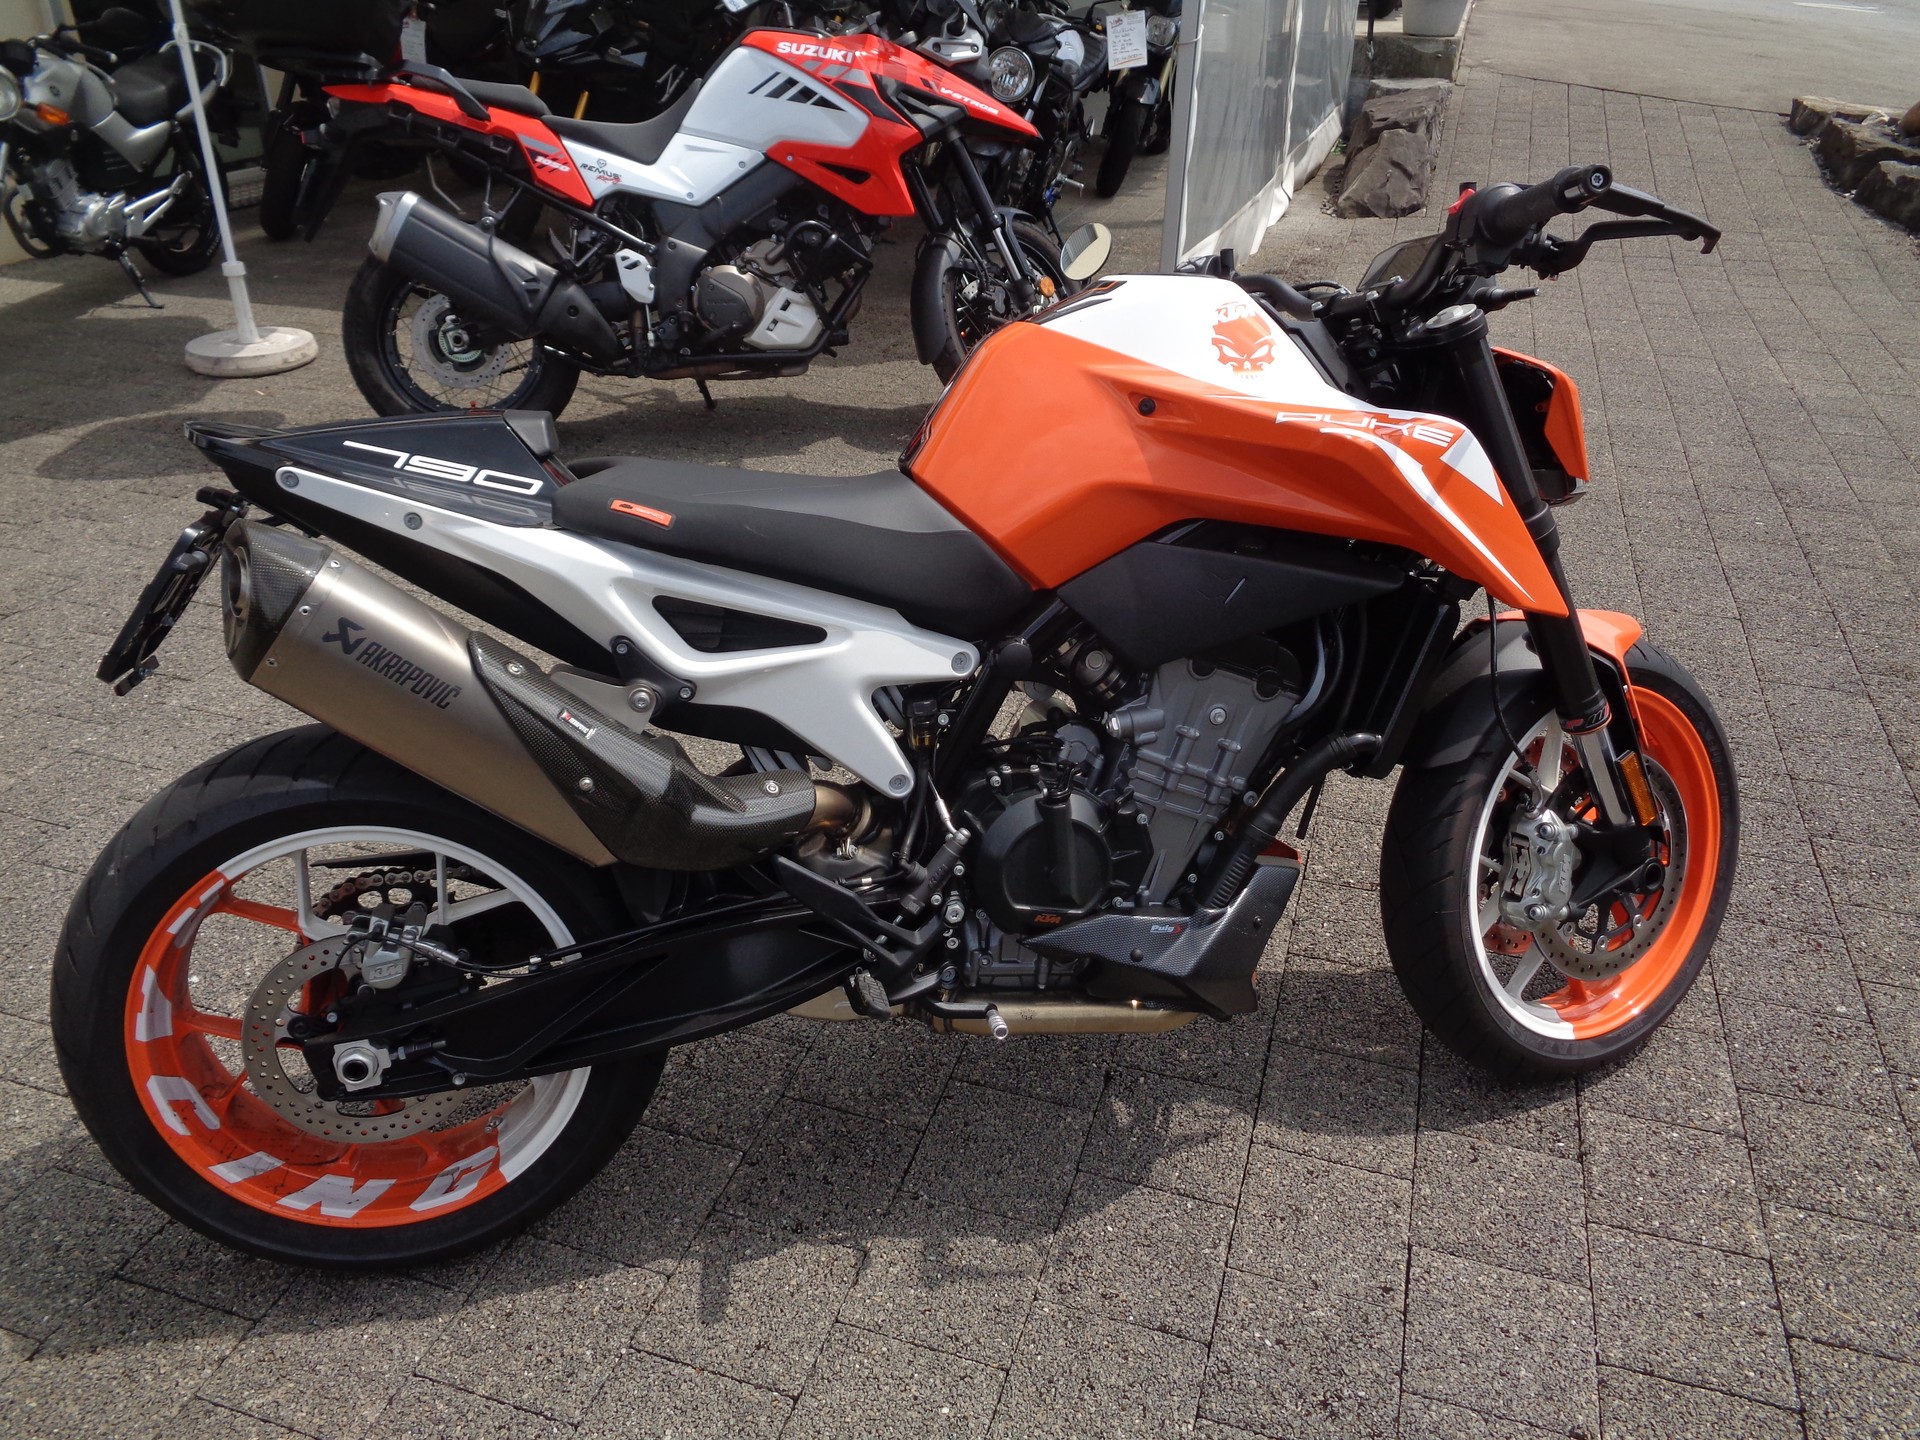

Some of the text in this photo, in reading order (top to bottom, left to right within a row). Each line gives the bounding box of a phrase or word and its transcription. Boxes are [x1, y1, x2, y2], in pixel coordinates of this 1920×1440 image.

[776, 41, 854, 63] SUZUKI
[940, 87, 999, 115] V-STROM
[580, 162, 621, 179] REMUS
[1275, 411, 1455, 448] DUKE
[342, 440, 544, 496] 790
[1034, 913, 1062, 924] KTM
[1150, 924, 1175, 934] Puig
